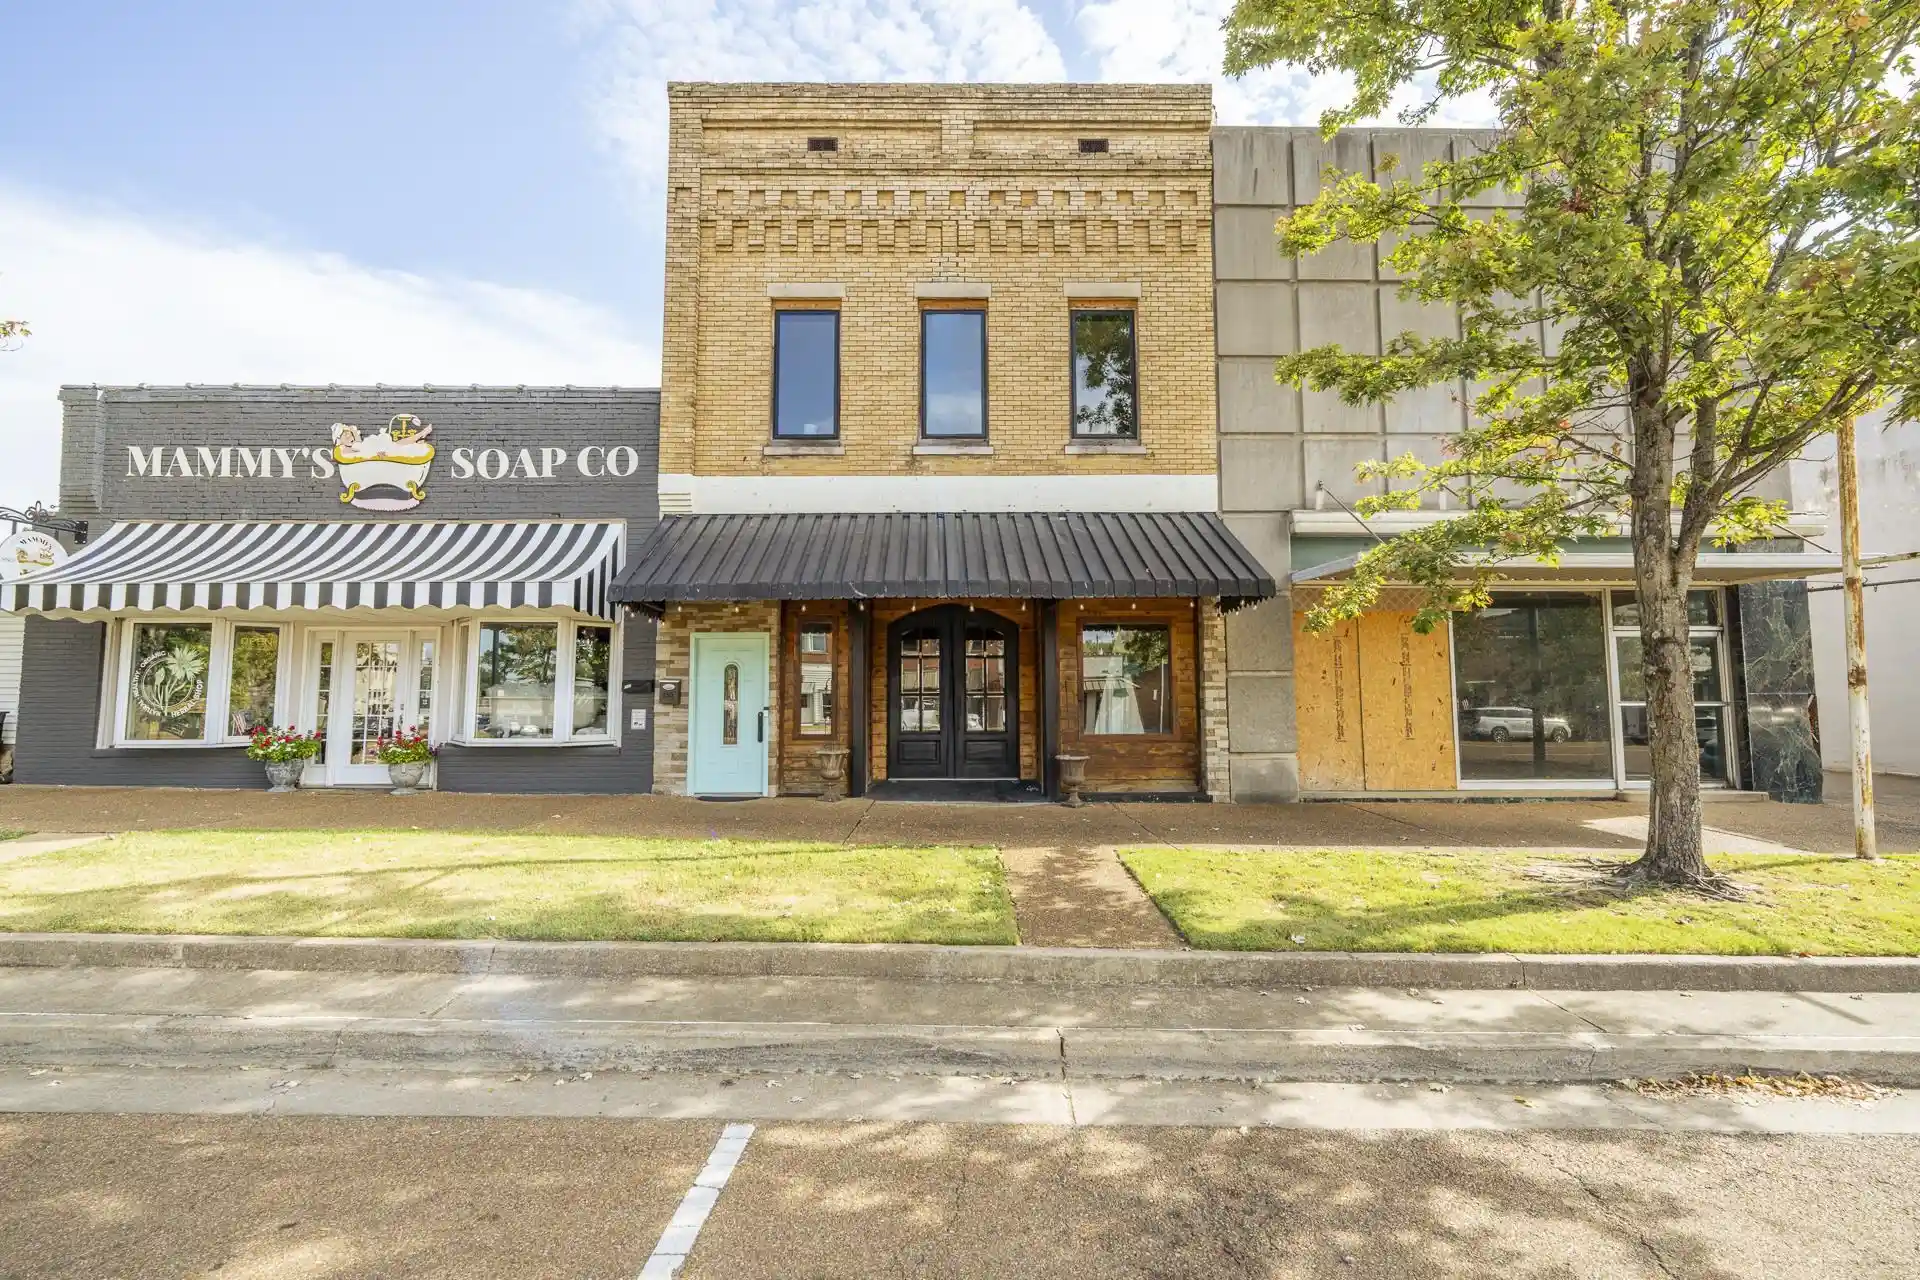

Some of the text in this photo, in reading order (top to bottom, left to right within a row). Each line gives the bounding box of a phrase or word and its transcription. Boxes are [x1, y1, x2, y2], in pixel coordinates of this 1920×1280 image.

[127, 445, 639, 480] MAMMY'S SOAP CO
[140, 650, 167, 668] ORGANIC
[171, 679, 204, 718] HERBAL SHOP
